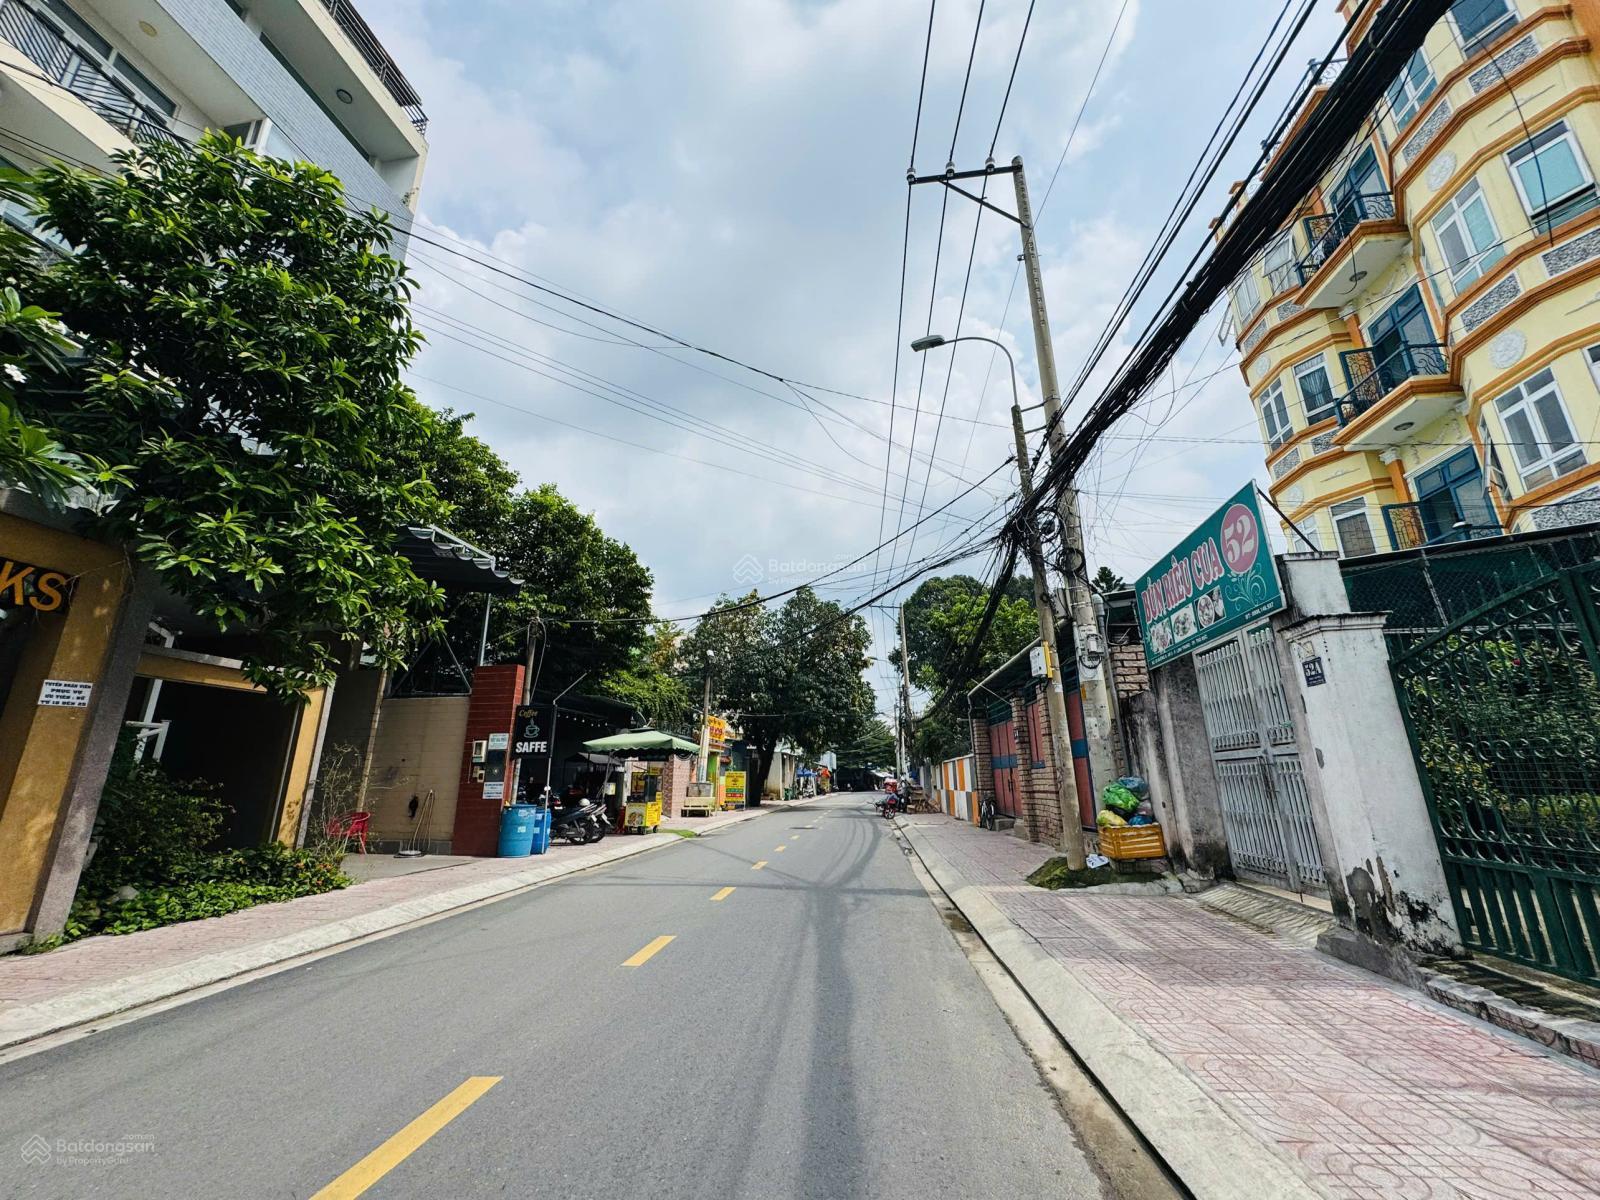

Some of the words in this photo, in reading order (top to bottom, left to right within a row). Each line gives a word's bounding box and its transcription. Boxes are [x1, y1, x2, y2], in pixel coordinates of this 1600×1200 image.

[1224, 514, 1255, 564] 52
[1190, 536, 1225, 591] CUA
[1304, 661, 1322, 677] 52A
[515, 741, 548, 753] SAFFE
